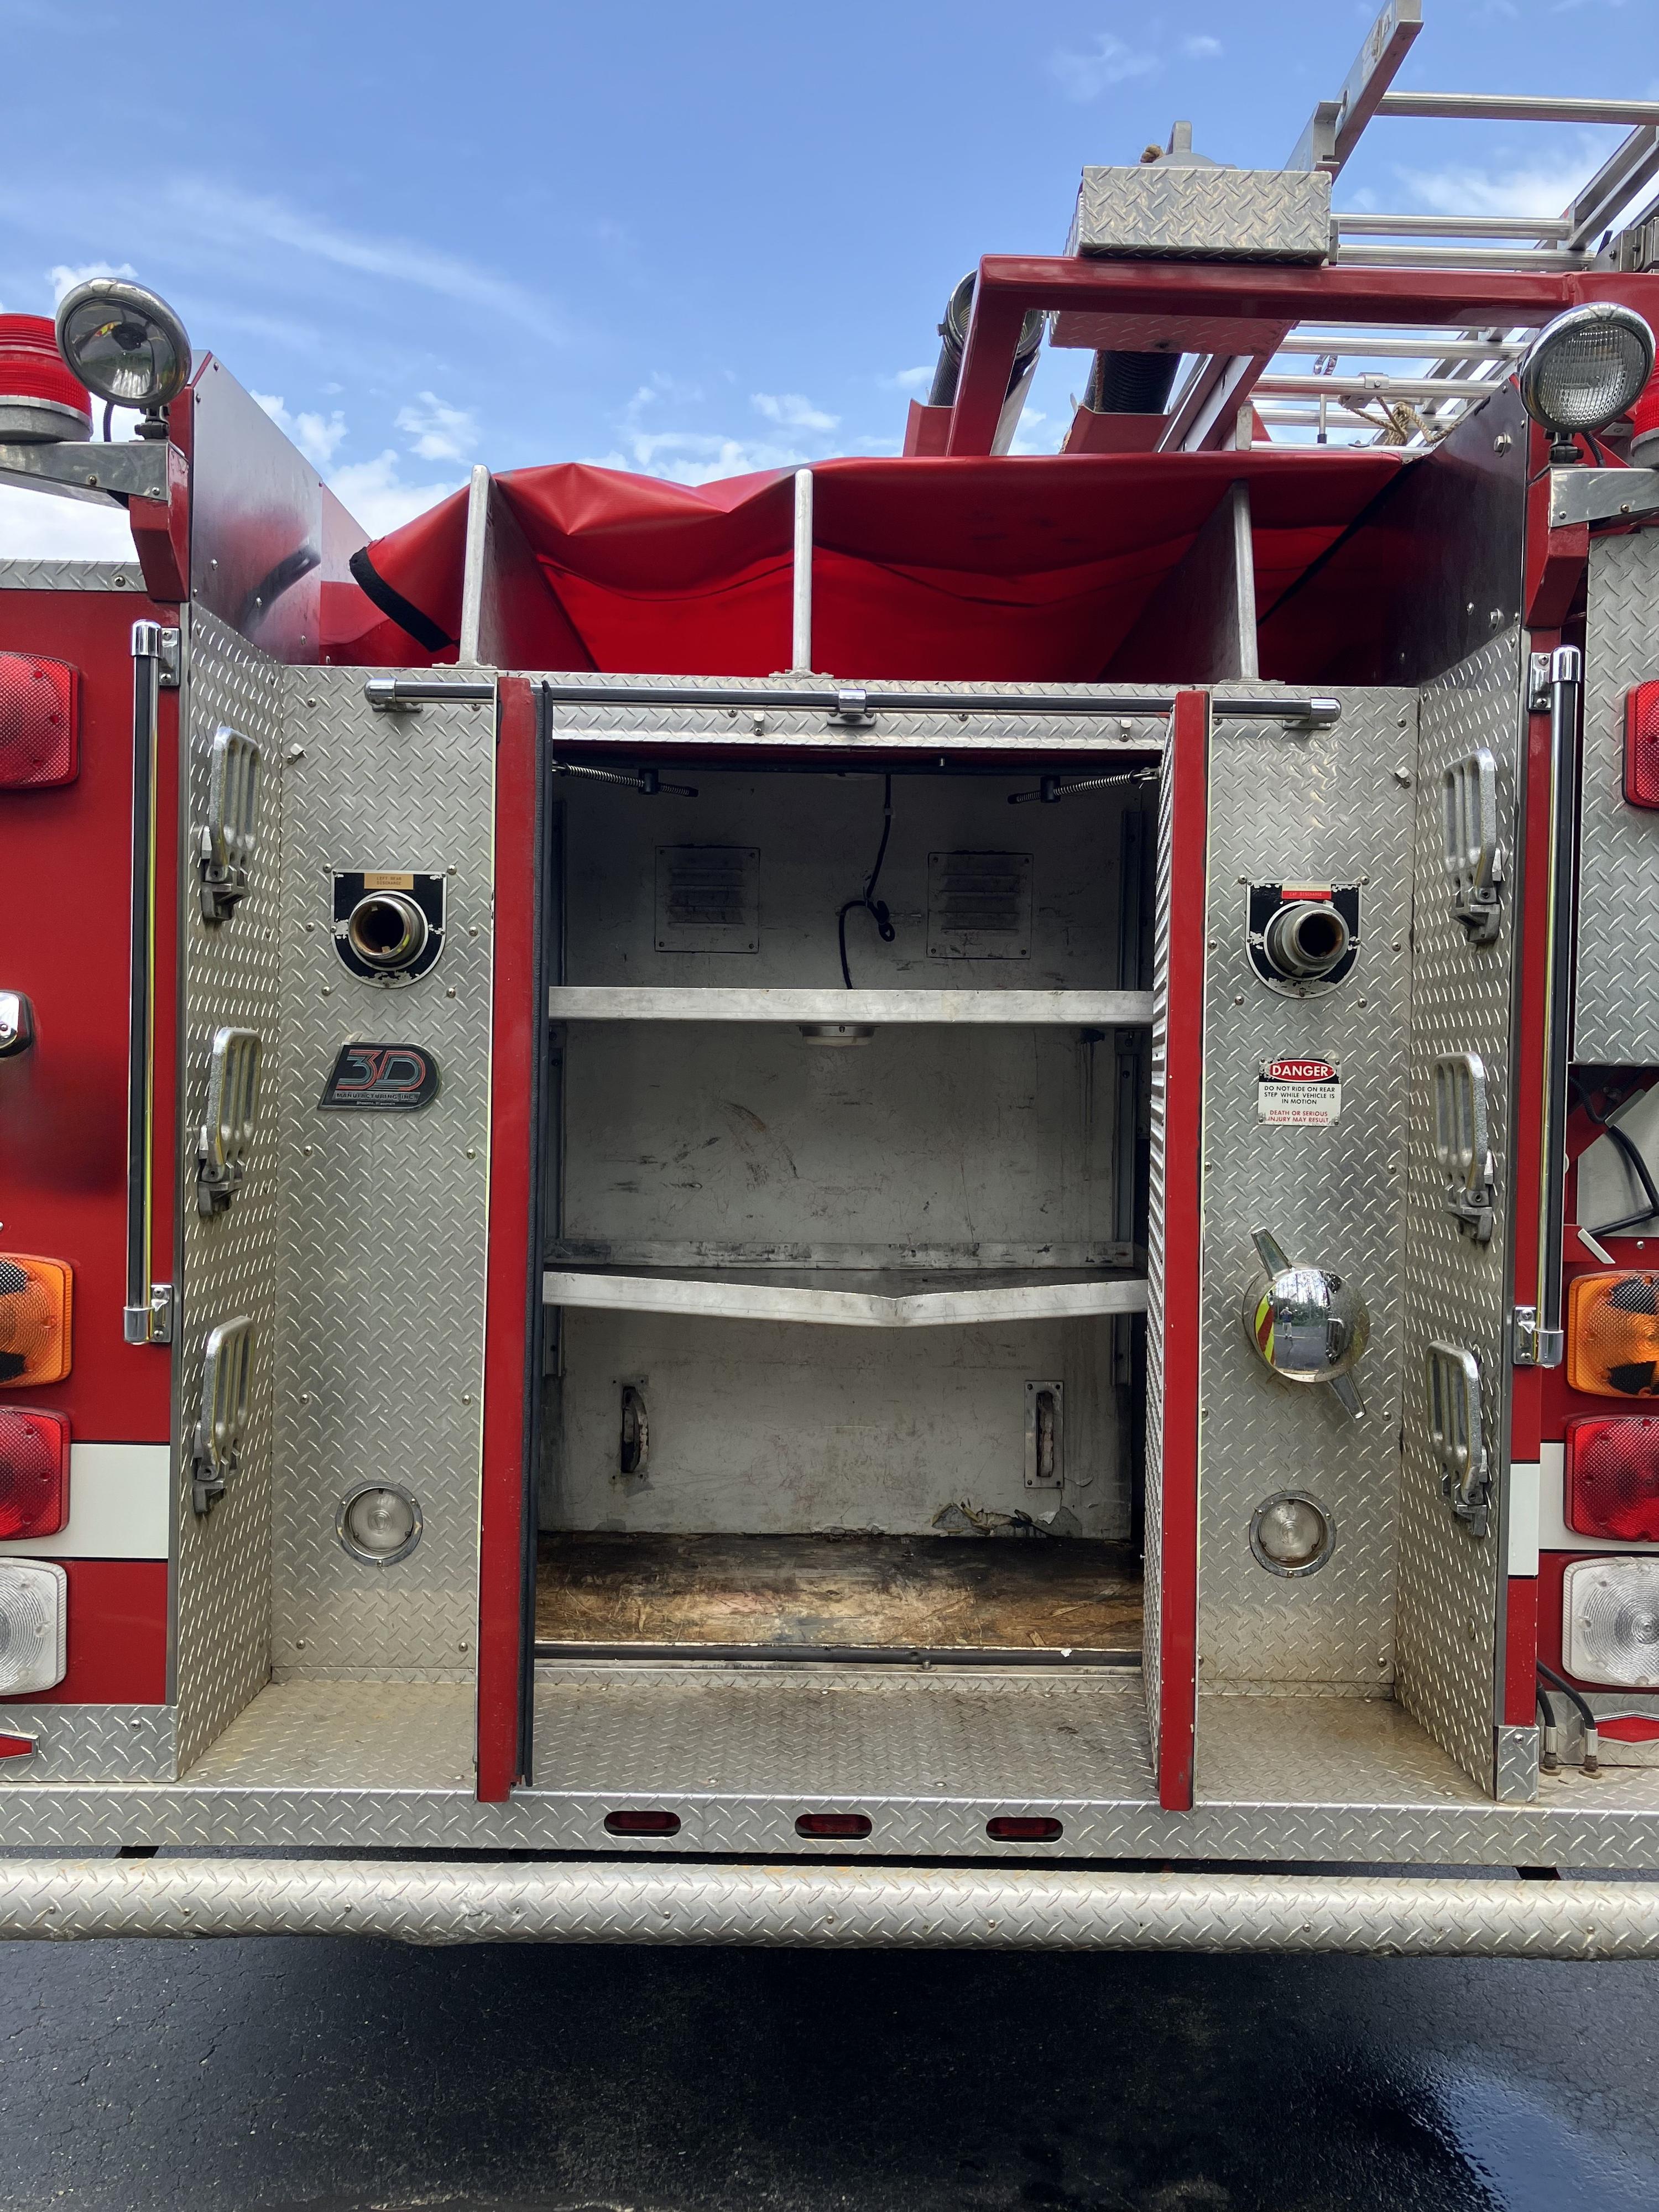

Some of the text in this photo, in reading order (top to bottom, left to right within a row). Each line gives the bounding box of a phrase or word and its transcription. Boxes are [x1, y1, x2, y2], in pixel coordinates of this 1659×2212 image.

[336, 1049, 426, 1091] 3D
[1272, 1065, 1328, 1077] DANGER
[336, 1093, 399, 1101] MANUFACTURING,
